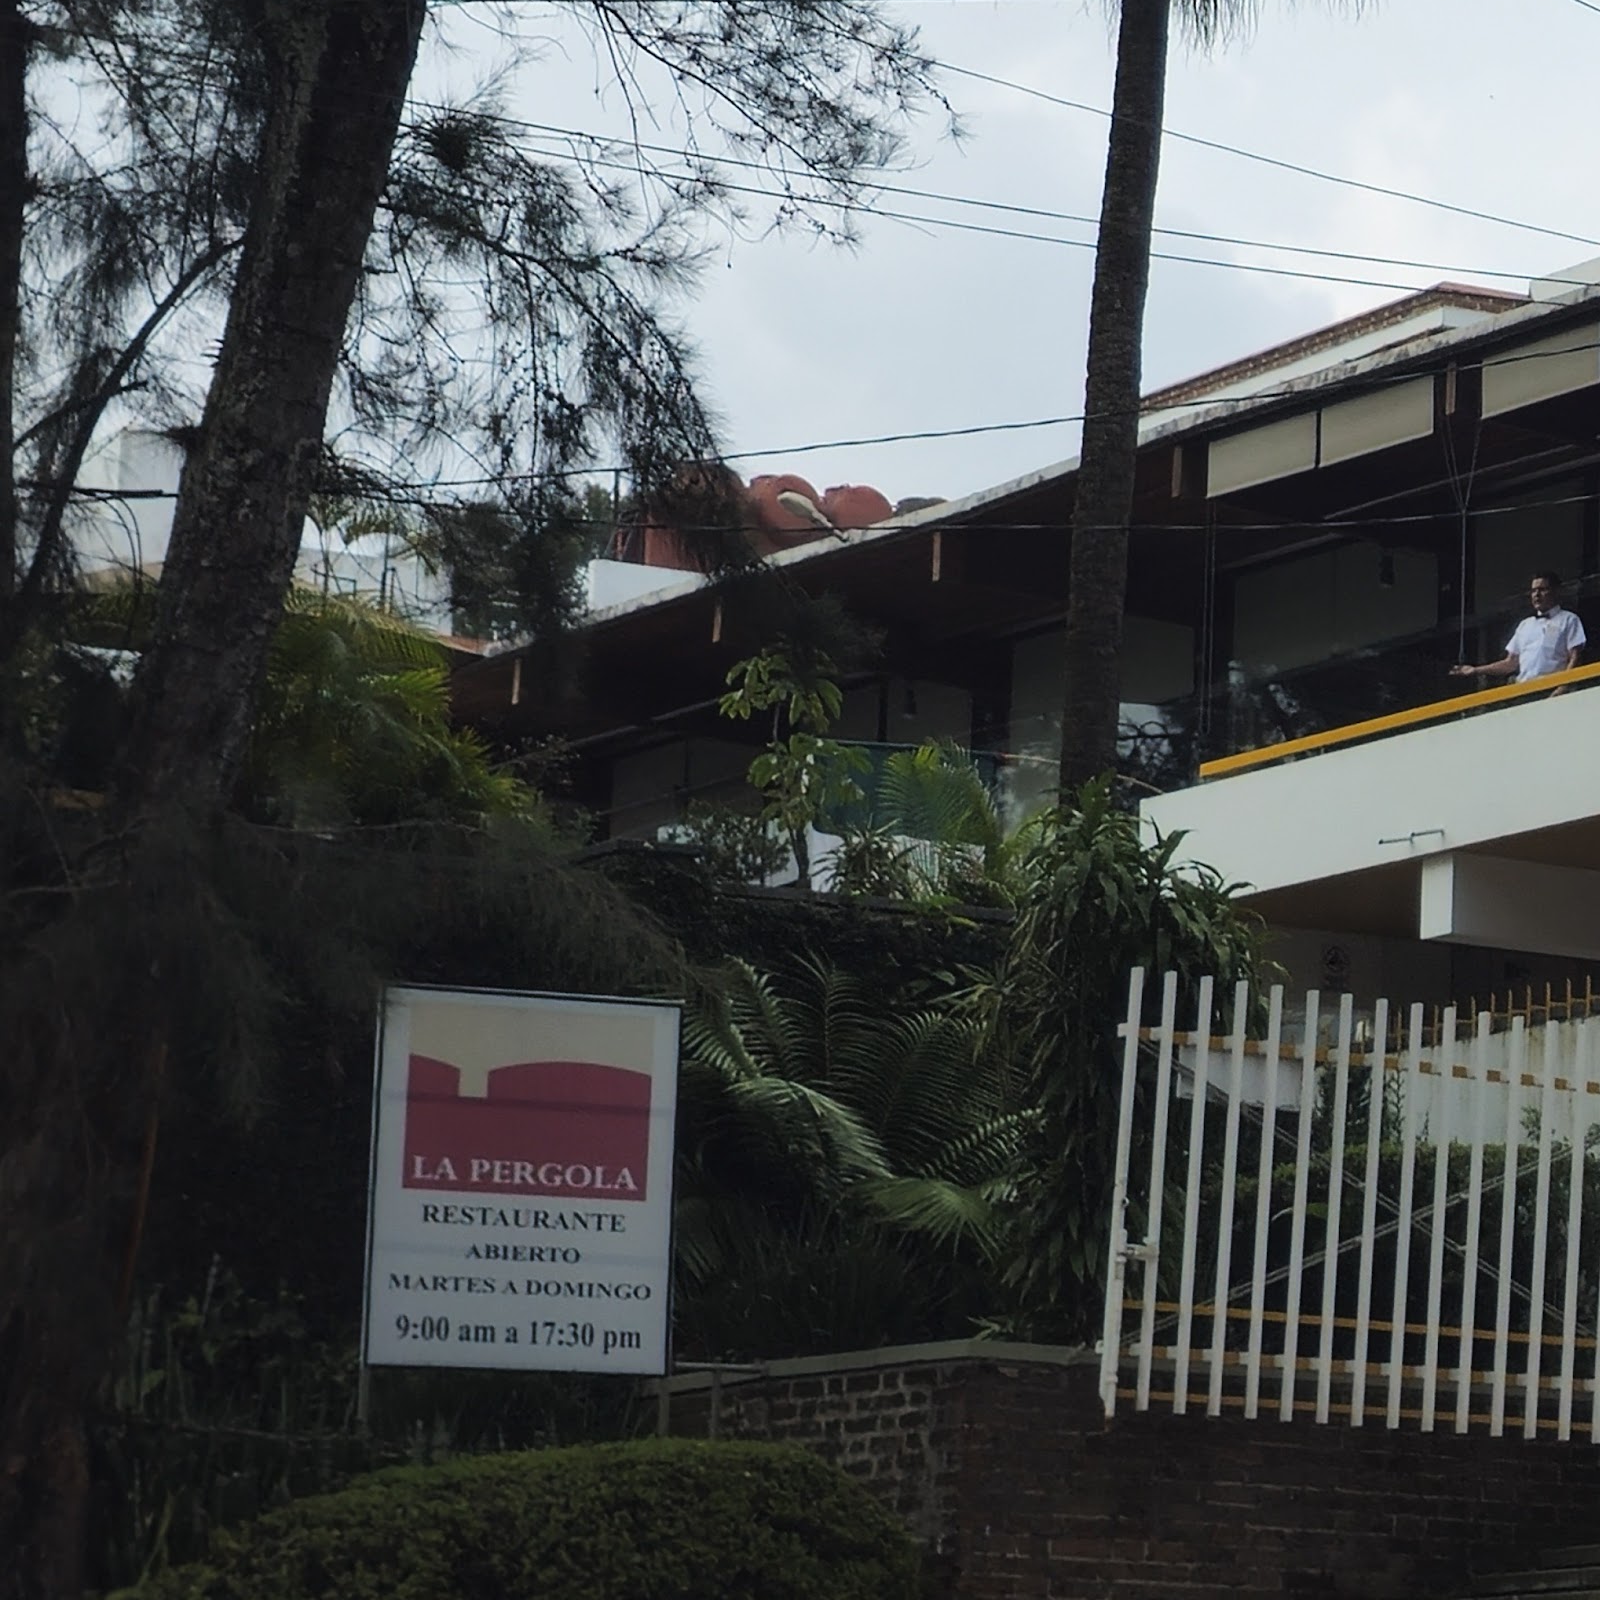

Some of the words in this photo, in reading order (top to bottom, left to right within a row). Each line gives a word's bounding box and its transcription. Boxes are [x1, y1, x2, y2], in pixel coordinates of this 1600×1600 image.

[413, 1155, 458, 1182] LA
[471, 1159, 638, 1191] PERGOLA
[422, 1203, 626, 1234] RESTAURANTE
[465, 1243, 581, 1265] ABIERTO
[388, 1273, 496, 1295] MARTES
[502, 1280, 519, 1296] A
[525, 1280, 652, 1301] DOMINGO
[395, 1314, 450, 1341] 9:00
[458, 1324, 495, 1345] am
[504, 1325, 519, 1344] a
[530, 1320, 595, 1348] 17:30
[602, 1327, 642, 1354] pm
